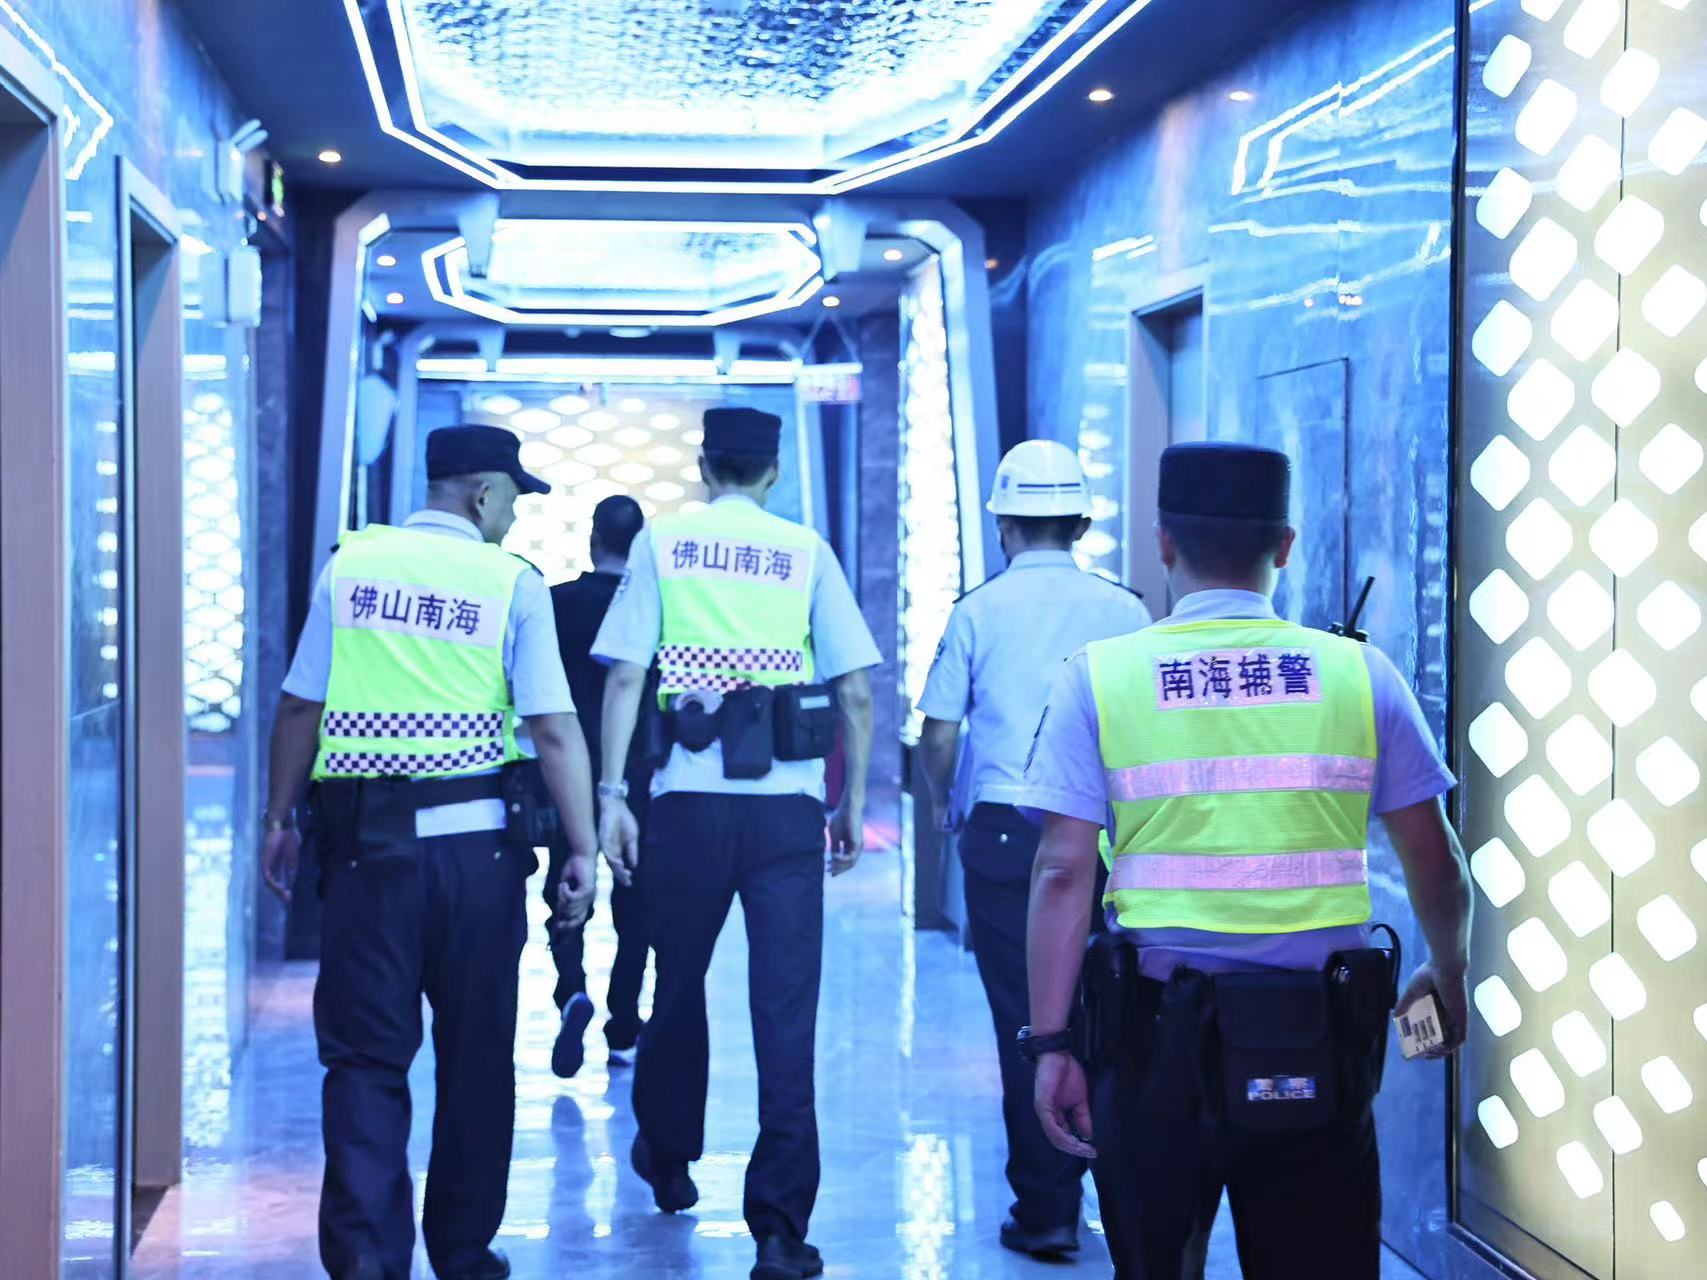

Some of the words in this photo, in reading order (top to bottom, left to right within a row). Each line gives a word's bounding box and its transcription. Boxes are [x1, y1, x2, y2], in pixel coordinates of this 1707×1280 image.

[671, 540, 792, 581] 佛山南海
[350, 585, 481, 635] 佛山南海
[1159, 653, 1312, 701] 南海辅警
[1247, 1089, 1315, 1101] POLICE
